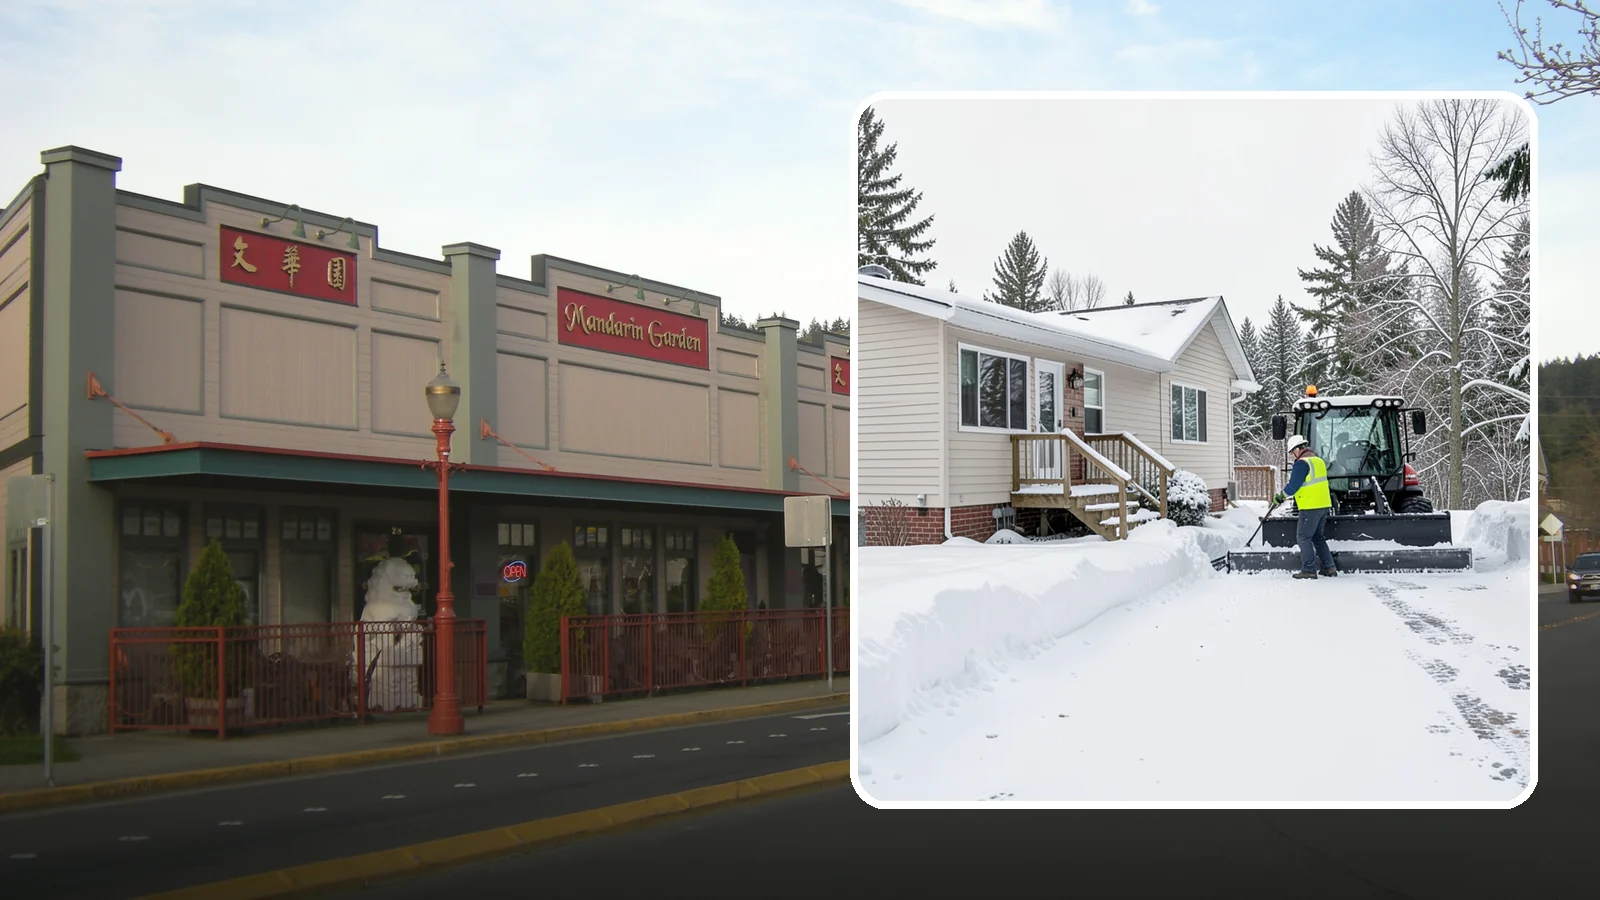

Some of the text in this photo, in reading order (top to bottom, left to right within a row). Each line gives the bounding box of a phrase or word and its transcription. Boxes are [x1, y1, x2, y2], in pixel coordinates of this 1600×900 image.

[230, 235, 346, 291] 文華園
[564, 302, 701, 352] Mandarin Garden
[503, 565, 527, 578] OPEN
